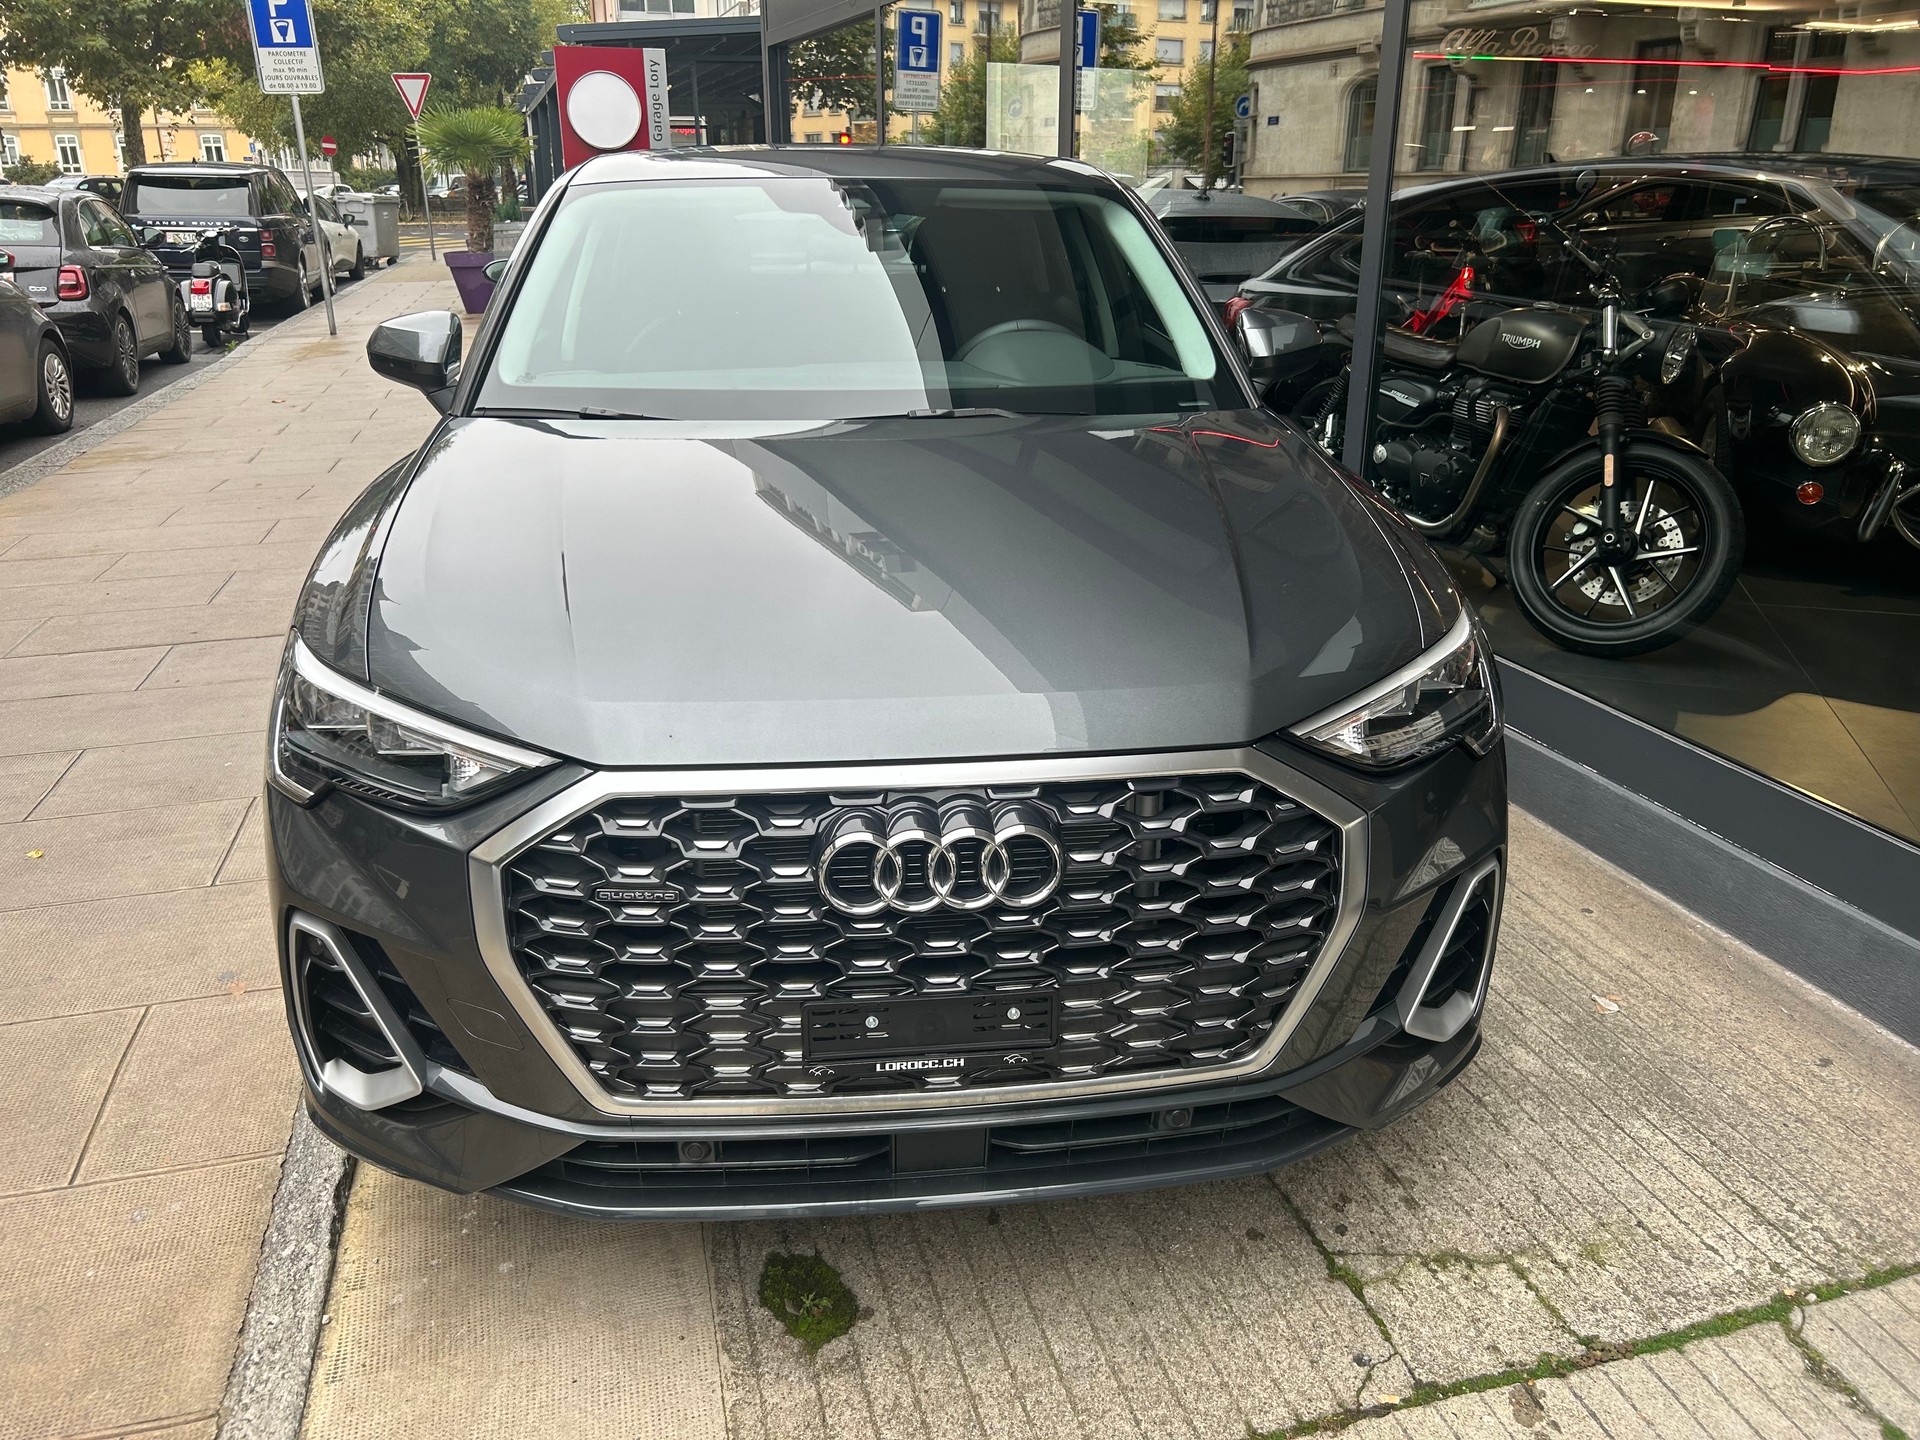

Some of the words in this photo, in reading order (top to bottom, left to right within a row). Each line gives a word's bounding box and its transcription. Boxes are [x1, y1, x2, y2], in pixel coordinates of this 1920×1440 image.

[1439, 27, 1502, 65] Alfa
[1506, 26, 1598, 57] Romeo
[650, 59, 661, 89] Lory
[652, 93, 664, 142] Garage
[1501, 333, 1541, 349] TRIUMPH
[599, 891, 675, 900] quattro
[875, 1058, 965, 1072] LOROCC.CH
